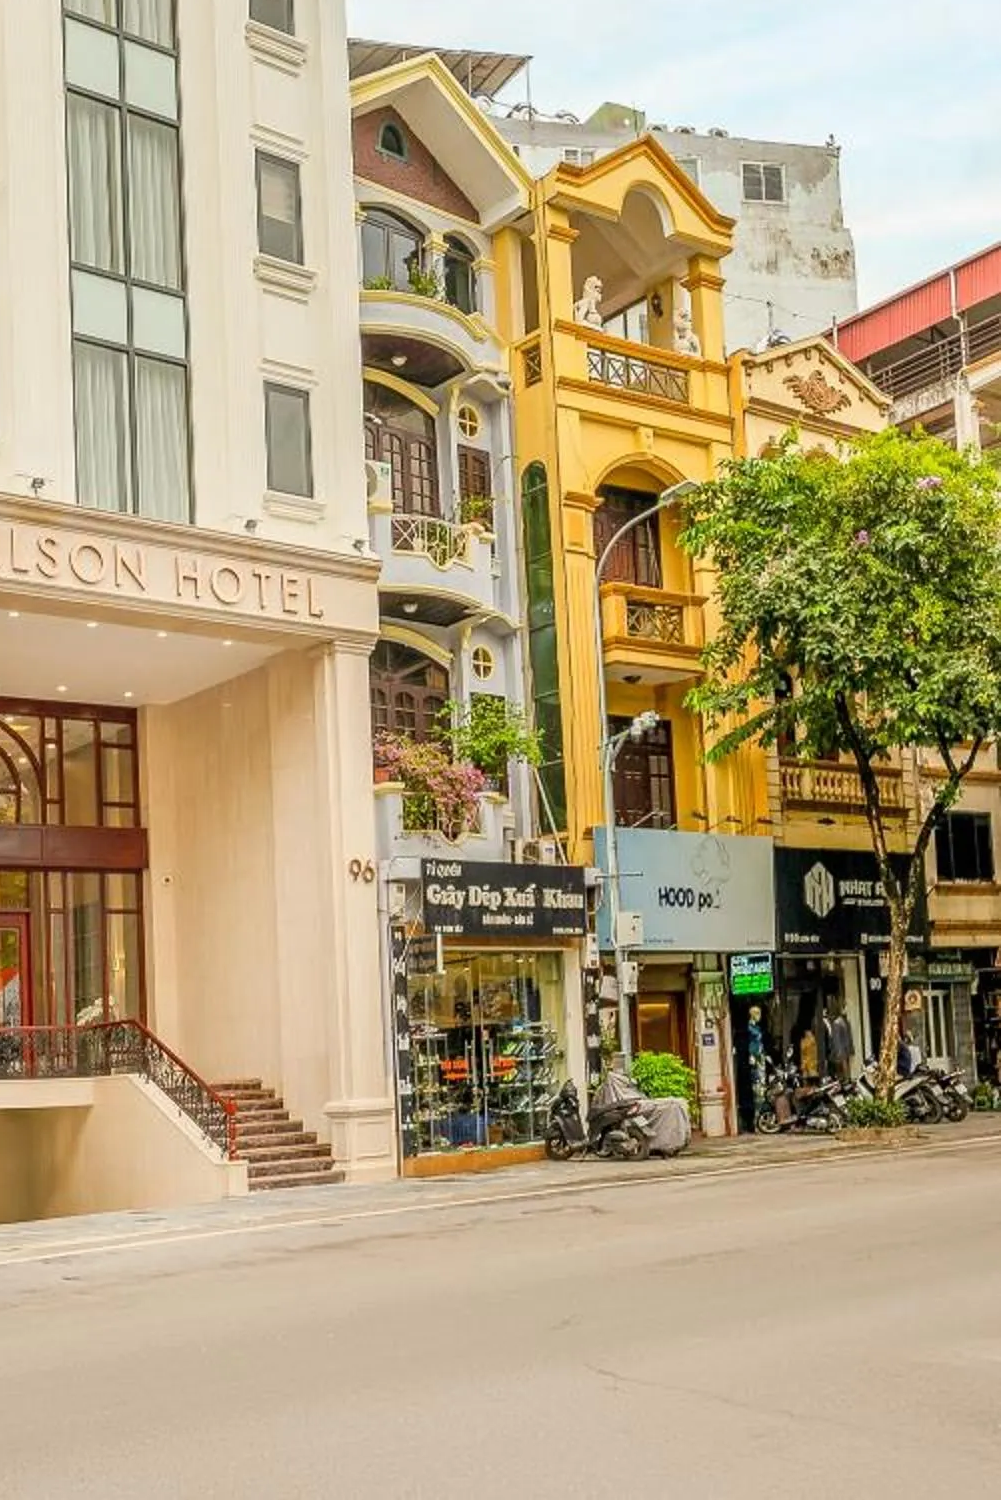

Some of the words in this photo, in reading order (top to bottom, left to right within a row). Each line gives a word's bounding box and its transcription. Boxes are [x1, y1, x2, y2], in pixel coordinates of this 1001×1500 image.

[174, 555, 325, 620] HOTEL
[349, 858, 376, 884] 96
[658, 886, 695, 908] HOOD
